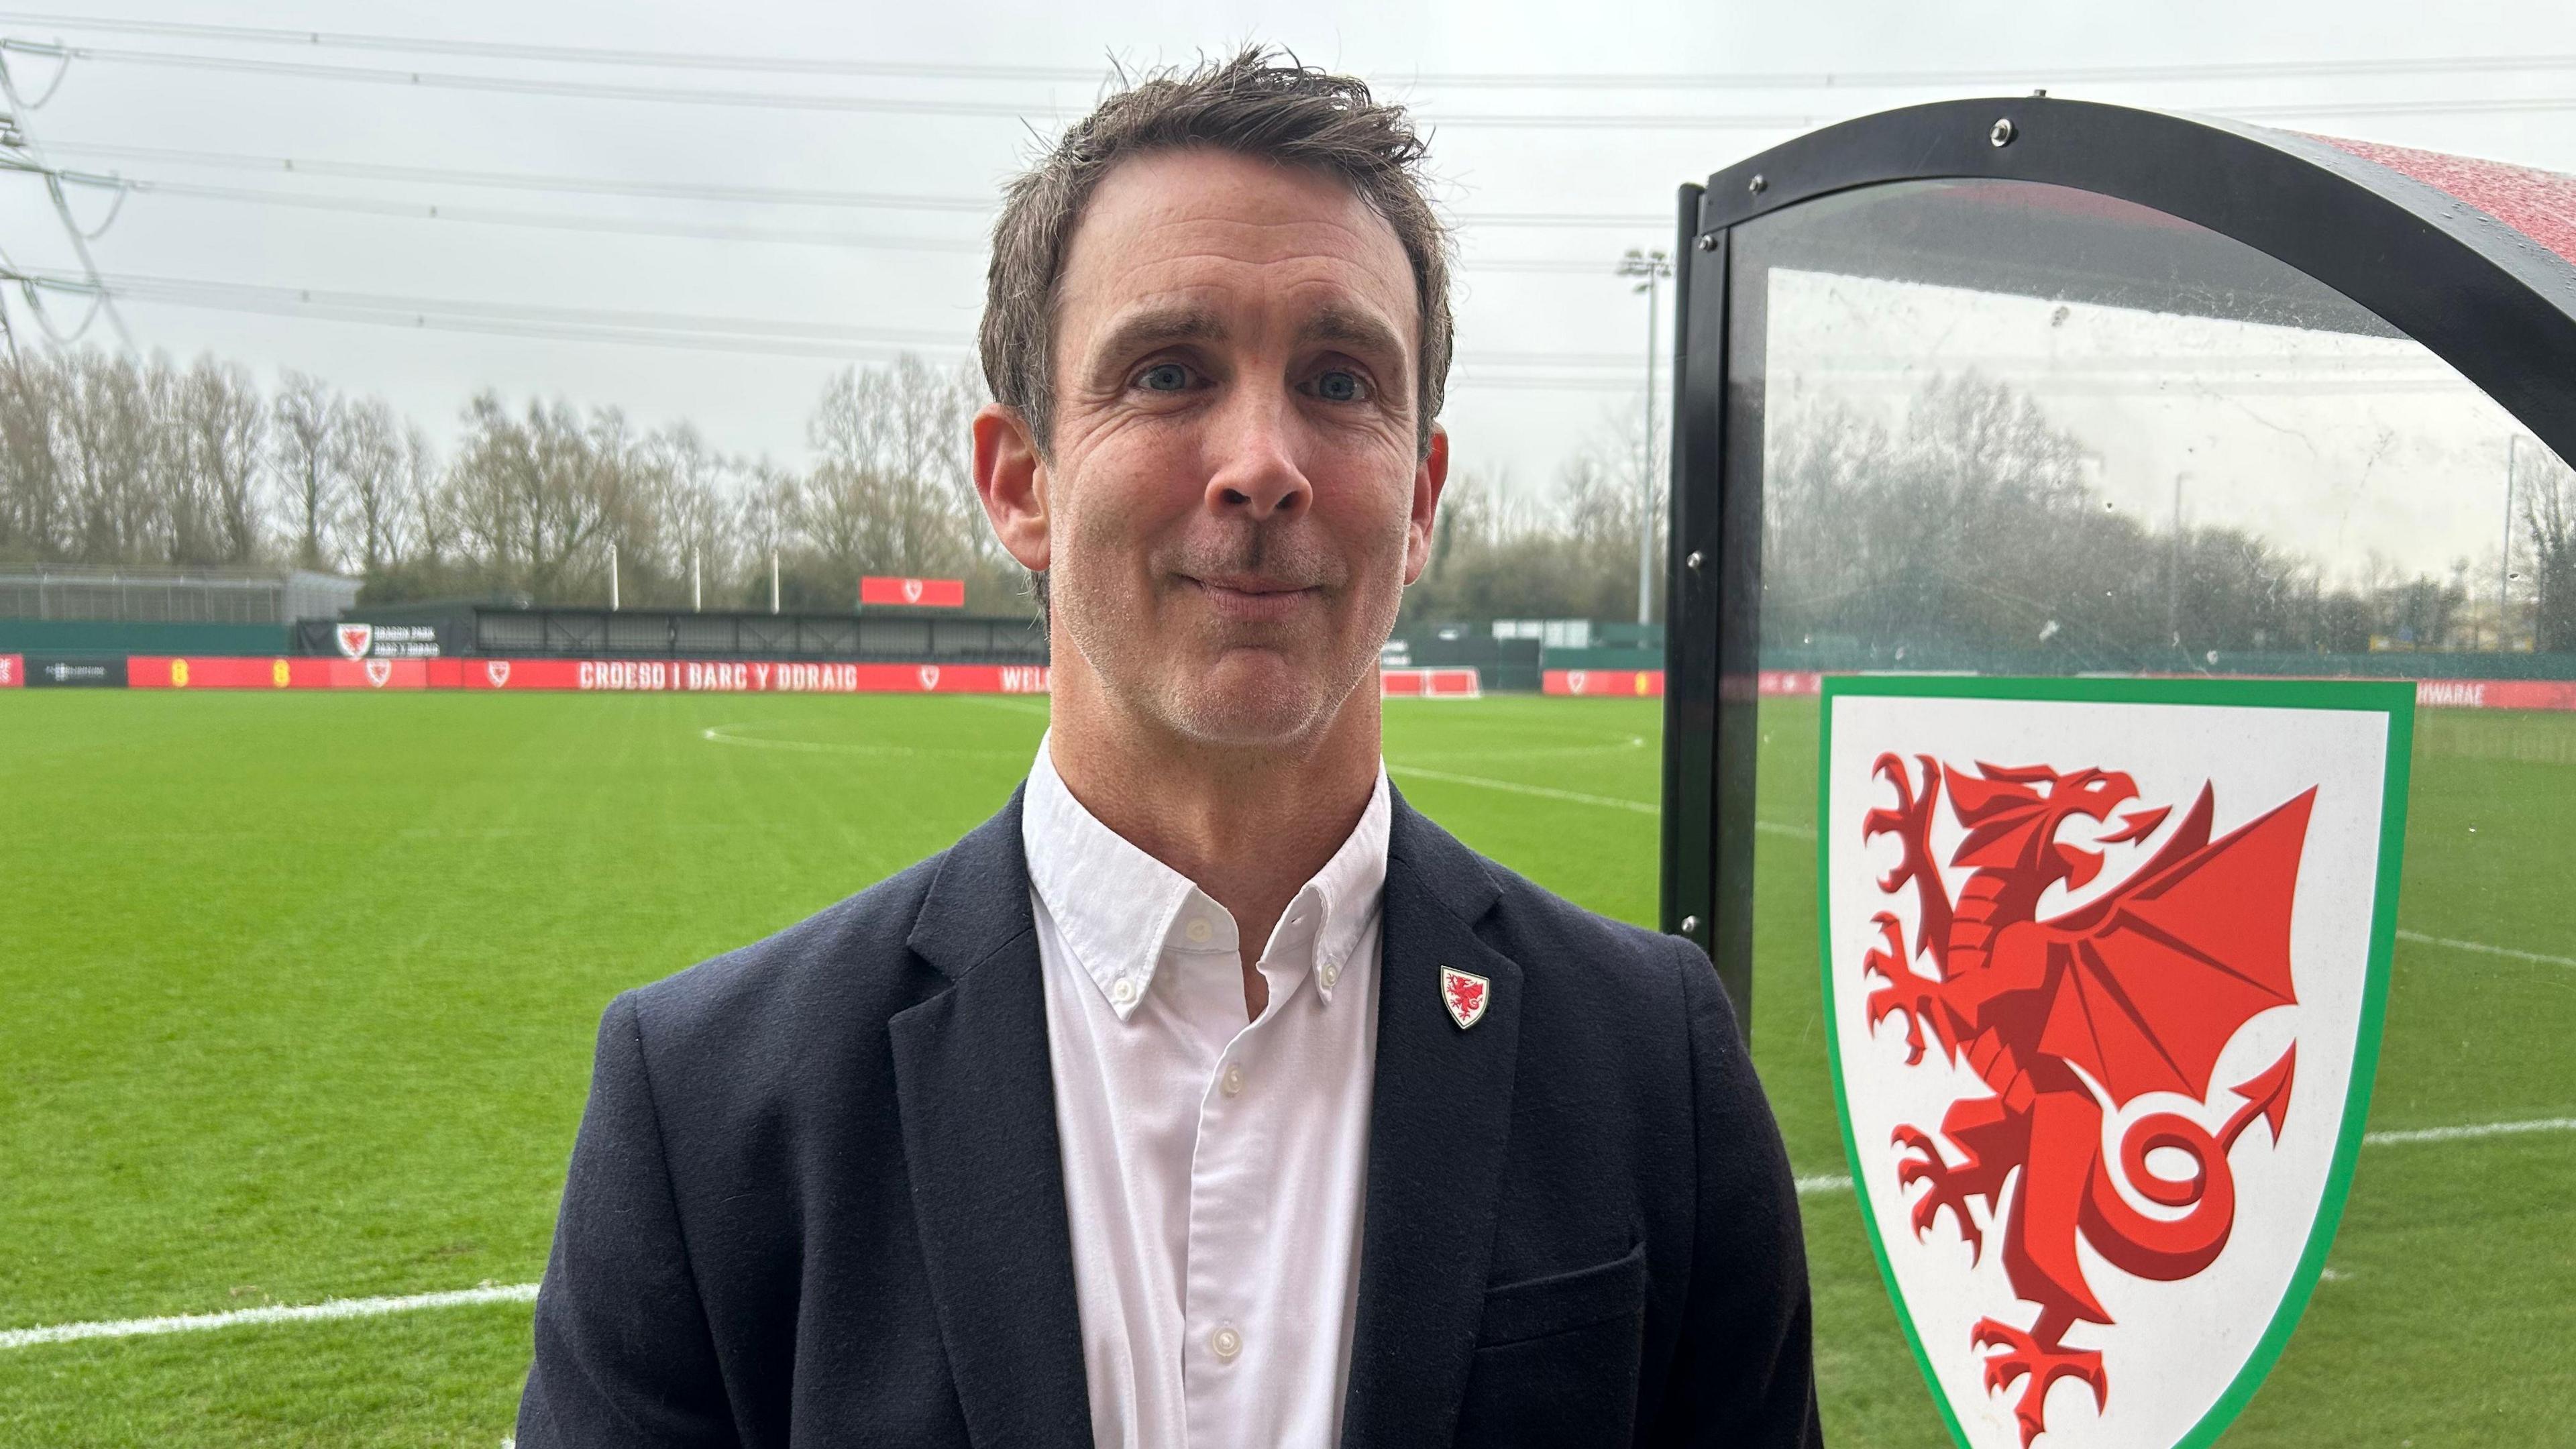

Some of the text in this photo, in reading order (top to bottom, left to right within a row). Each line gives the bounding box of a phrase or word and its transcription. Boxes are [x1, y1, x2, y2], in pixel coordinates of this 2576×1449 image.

[580, 661, 857, 692] CROESO I BARC Y DDRAIG
